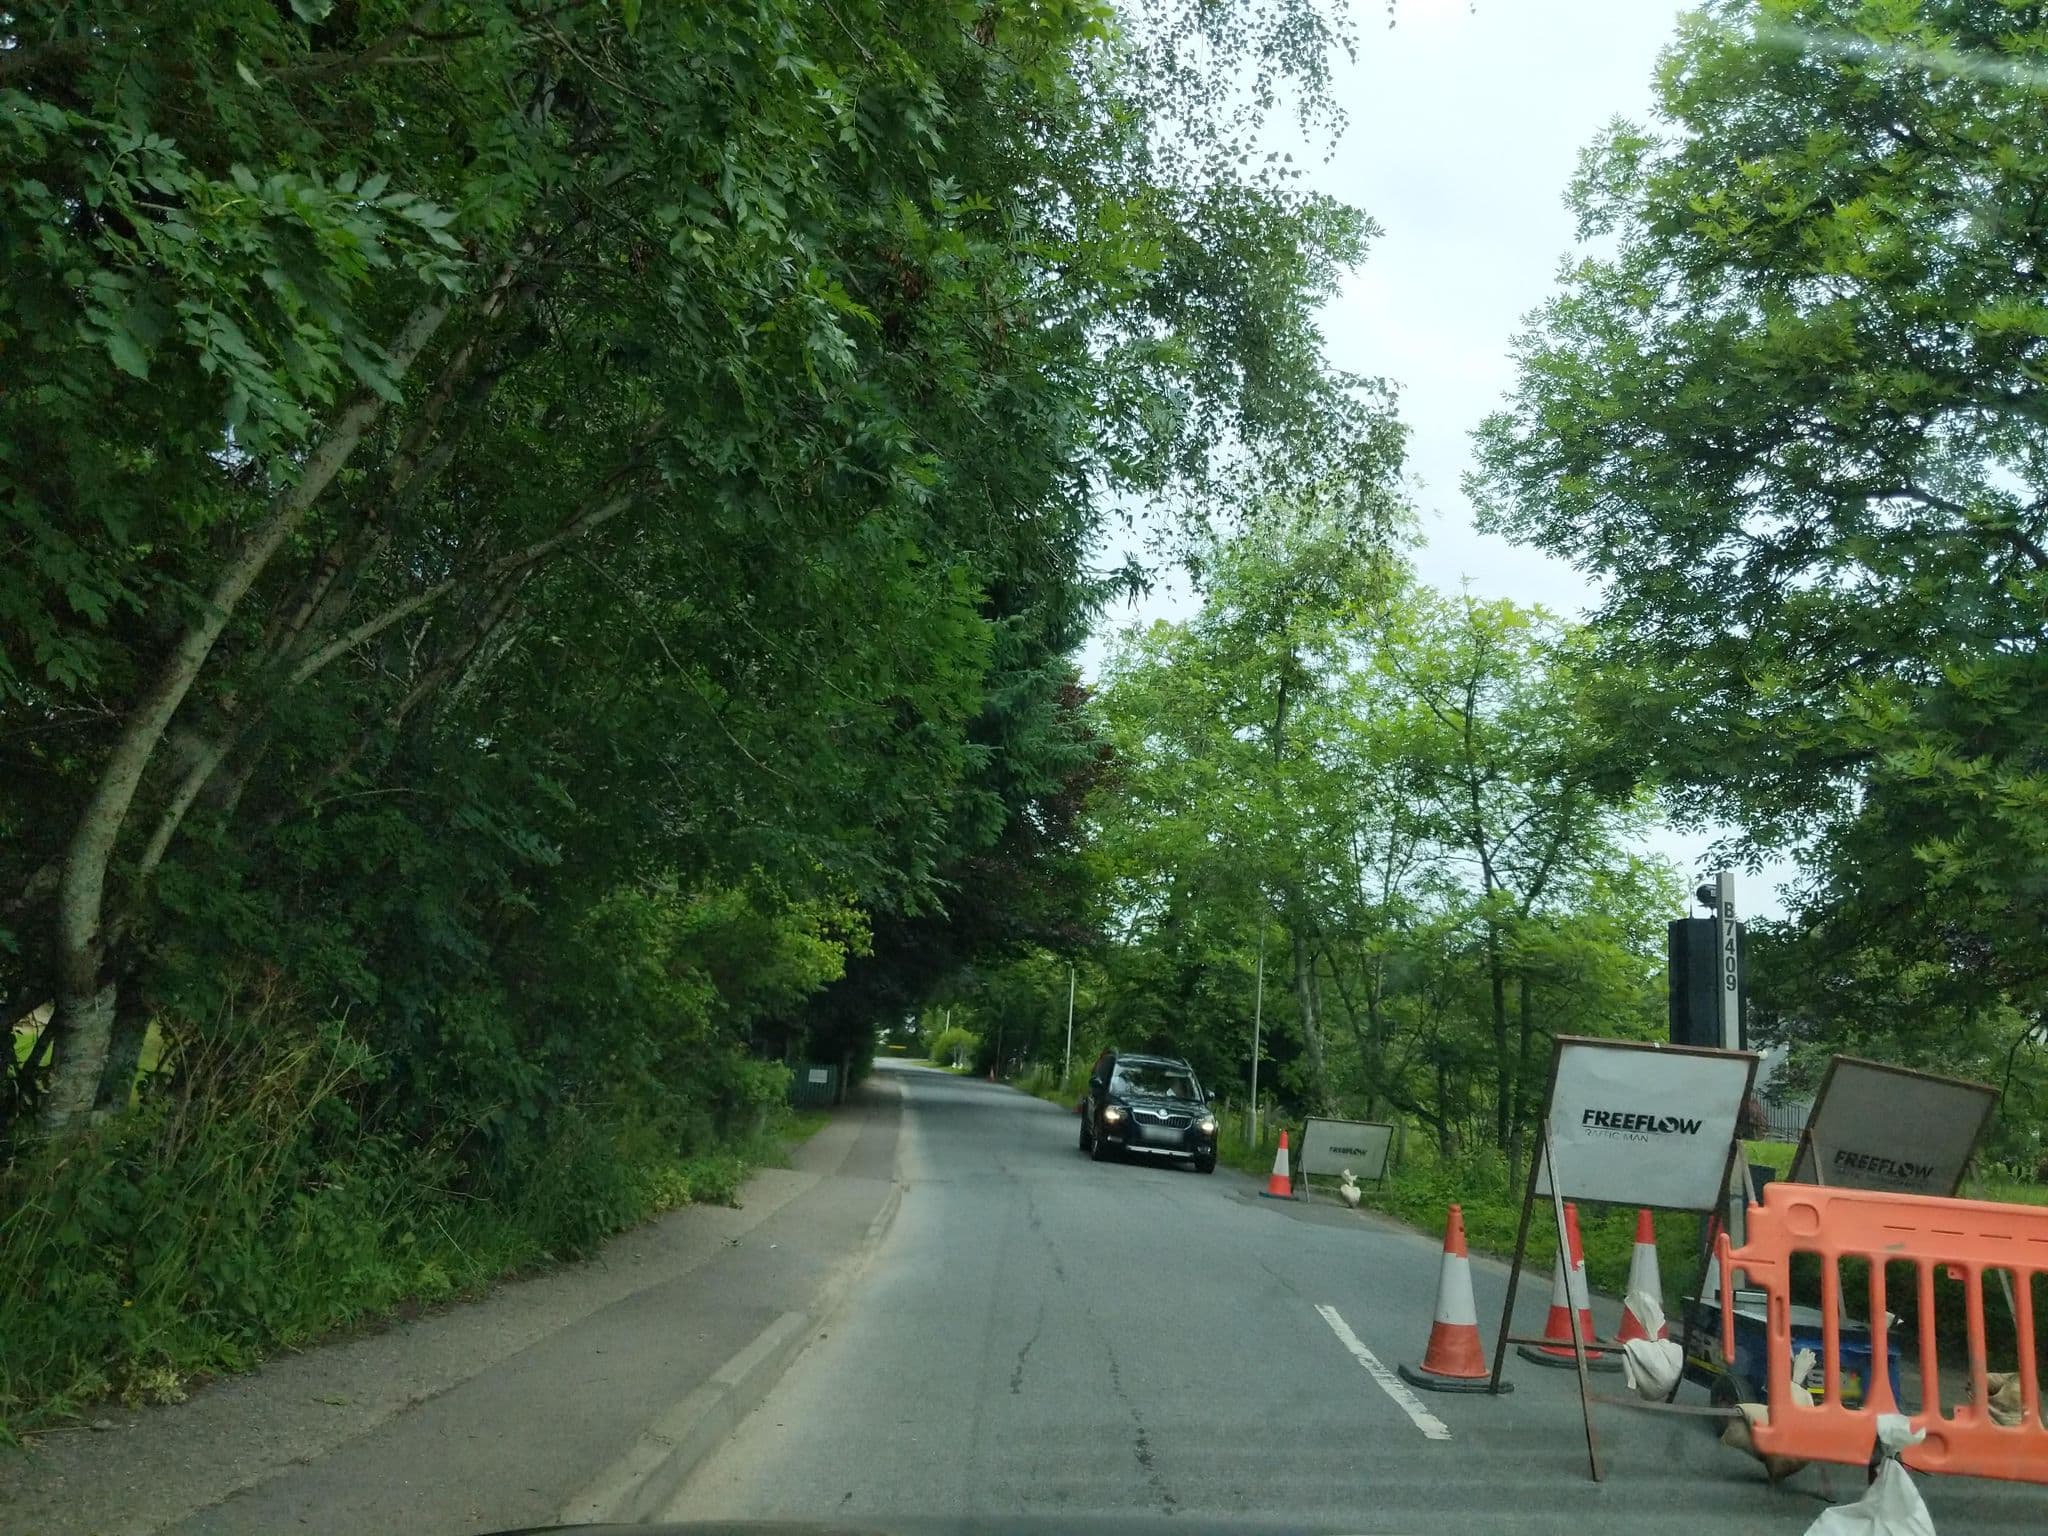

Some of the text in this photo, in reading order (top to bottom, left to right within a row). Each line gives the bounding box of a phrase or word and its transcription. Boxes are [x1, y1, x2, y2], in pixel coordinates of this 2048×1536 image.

[1722, 902, 1737, 991] B7409
[1582, 1109, 1703, 1134] FREEFLOW
[1833, 1150, 1934, 1177] FREEFLOW
